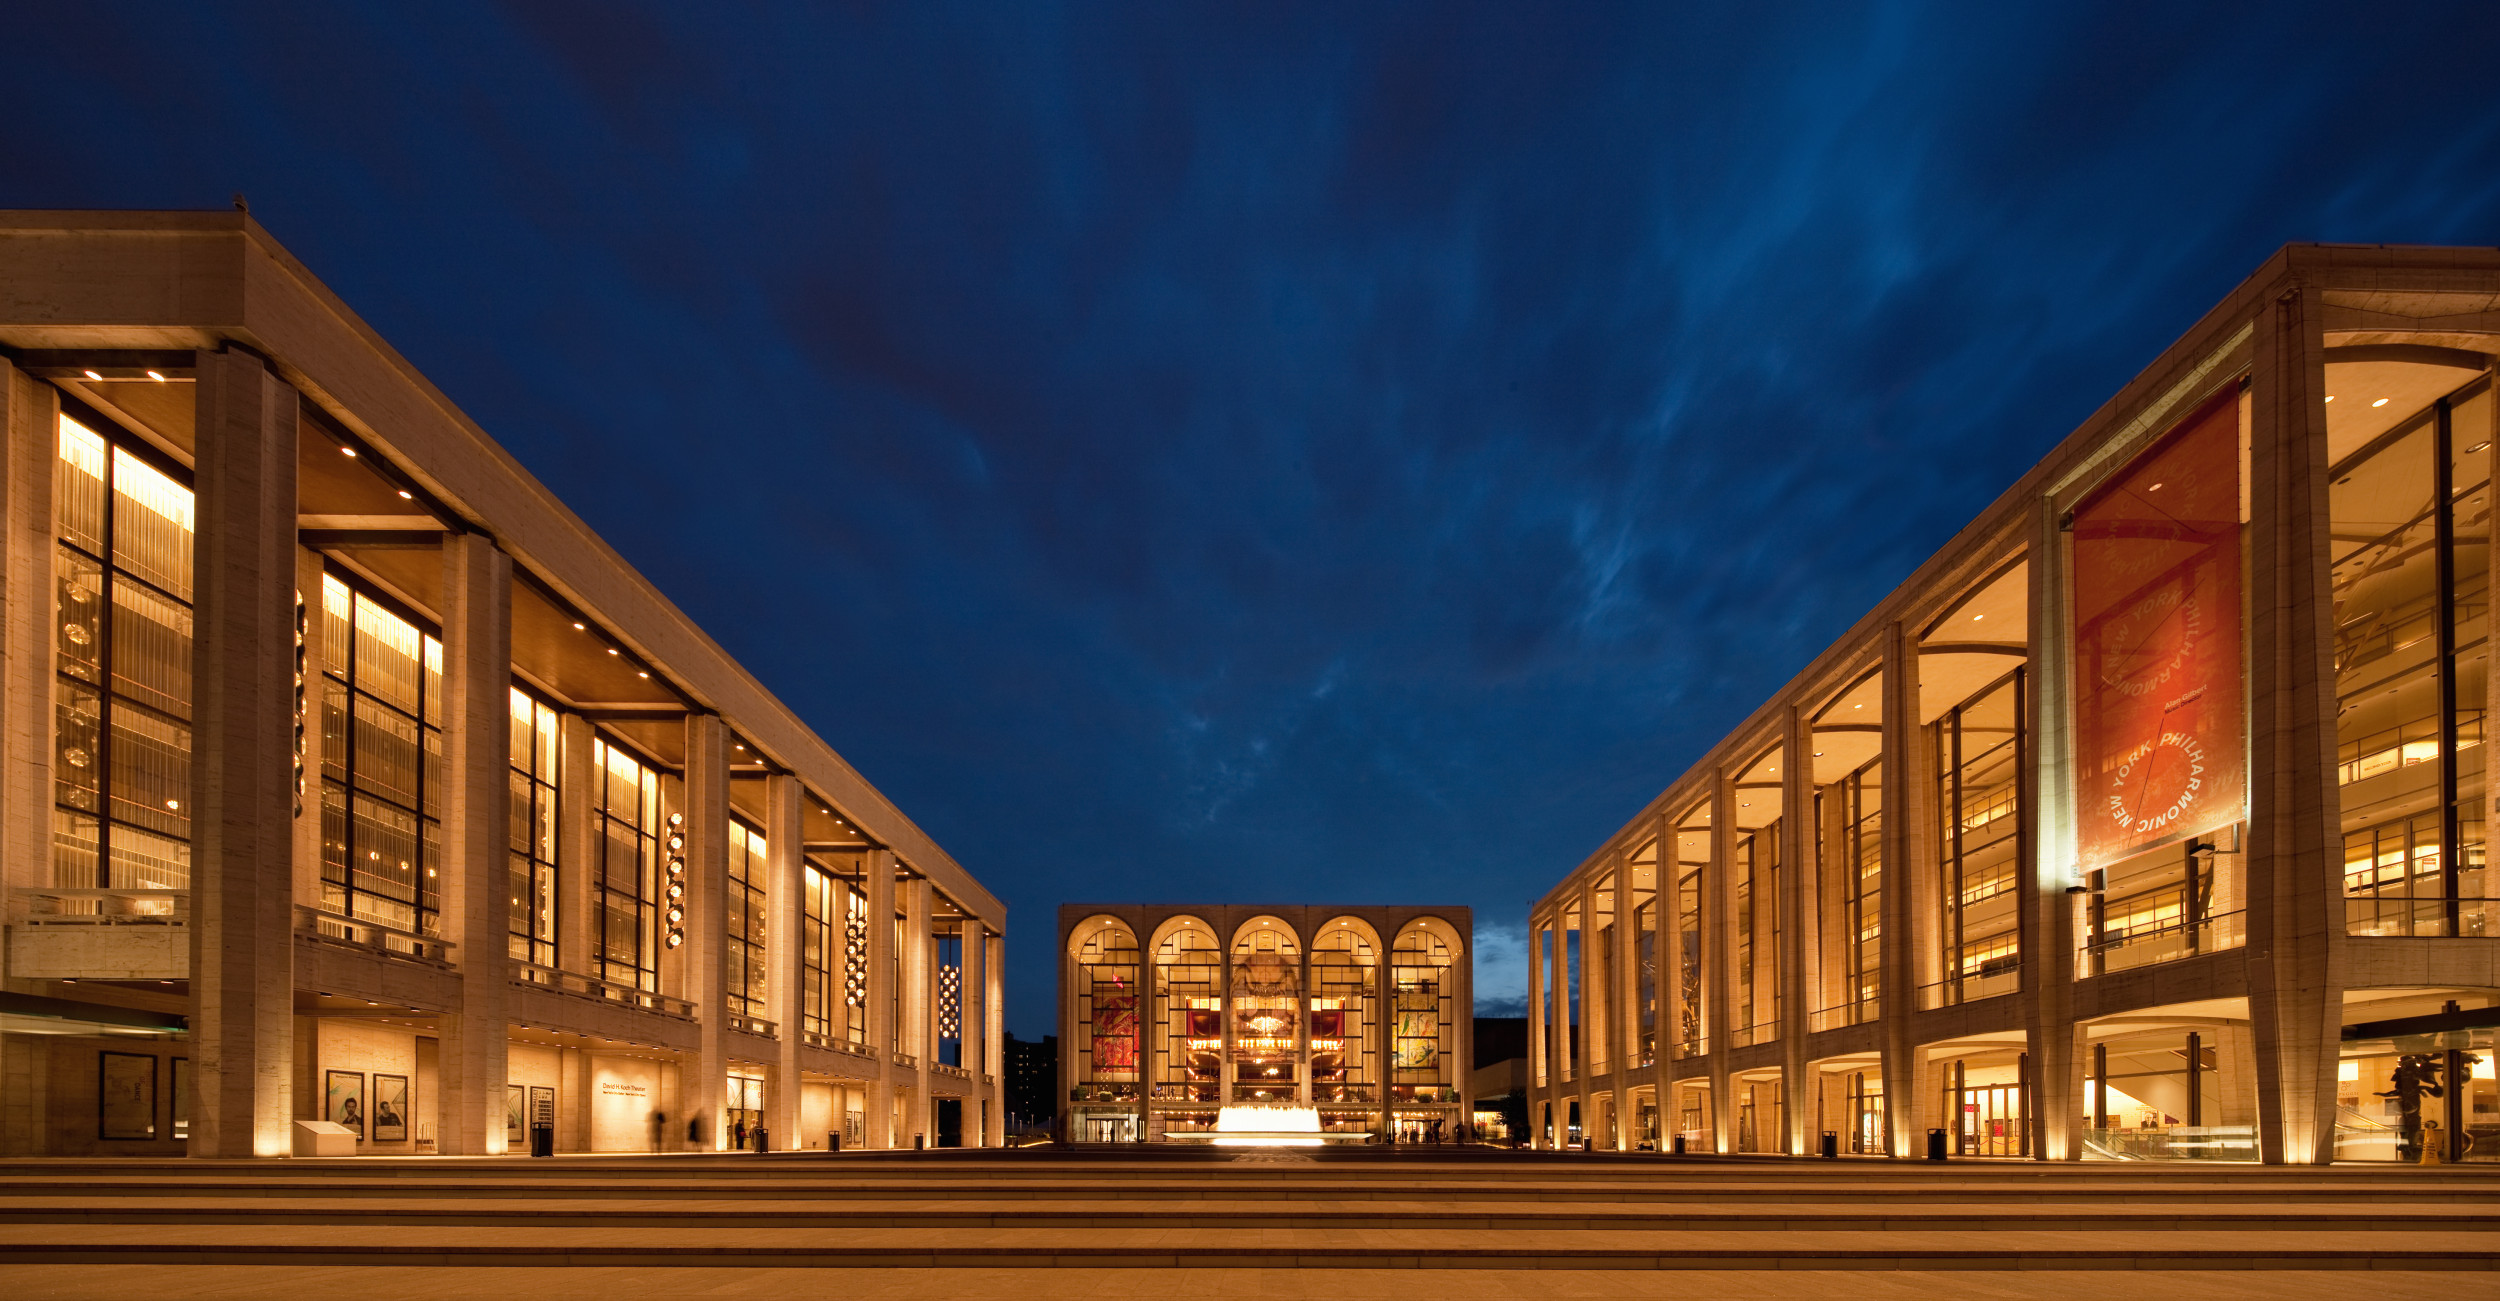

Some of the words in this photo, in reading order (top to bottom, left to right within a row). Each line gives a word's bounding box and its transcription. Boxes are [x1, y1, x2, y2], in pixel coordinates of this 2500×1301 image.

[2132, 589, 2183, 621] YORK
[2108, 624, 2130, 668] NEW
[2110, 597, 2201, 697] PHILHARMONIC
[2164, 697, 2181, 710] Alan
[2182, 684, 2208, 701] Gilbert
[2164, 704, 2180, 715] Music
[2113, 740, 2152, 787] YORK
[2136, 732, 2204, 833] PHILHARMONIC
[2110, 795, 2133, 828] NEW
